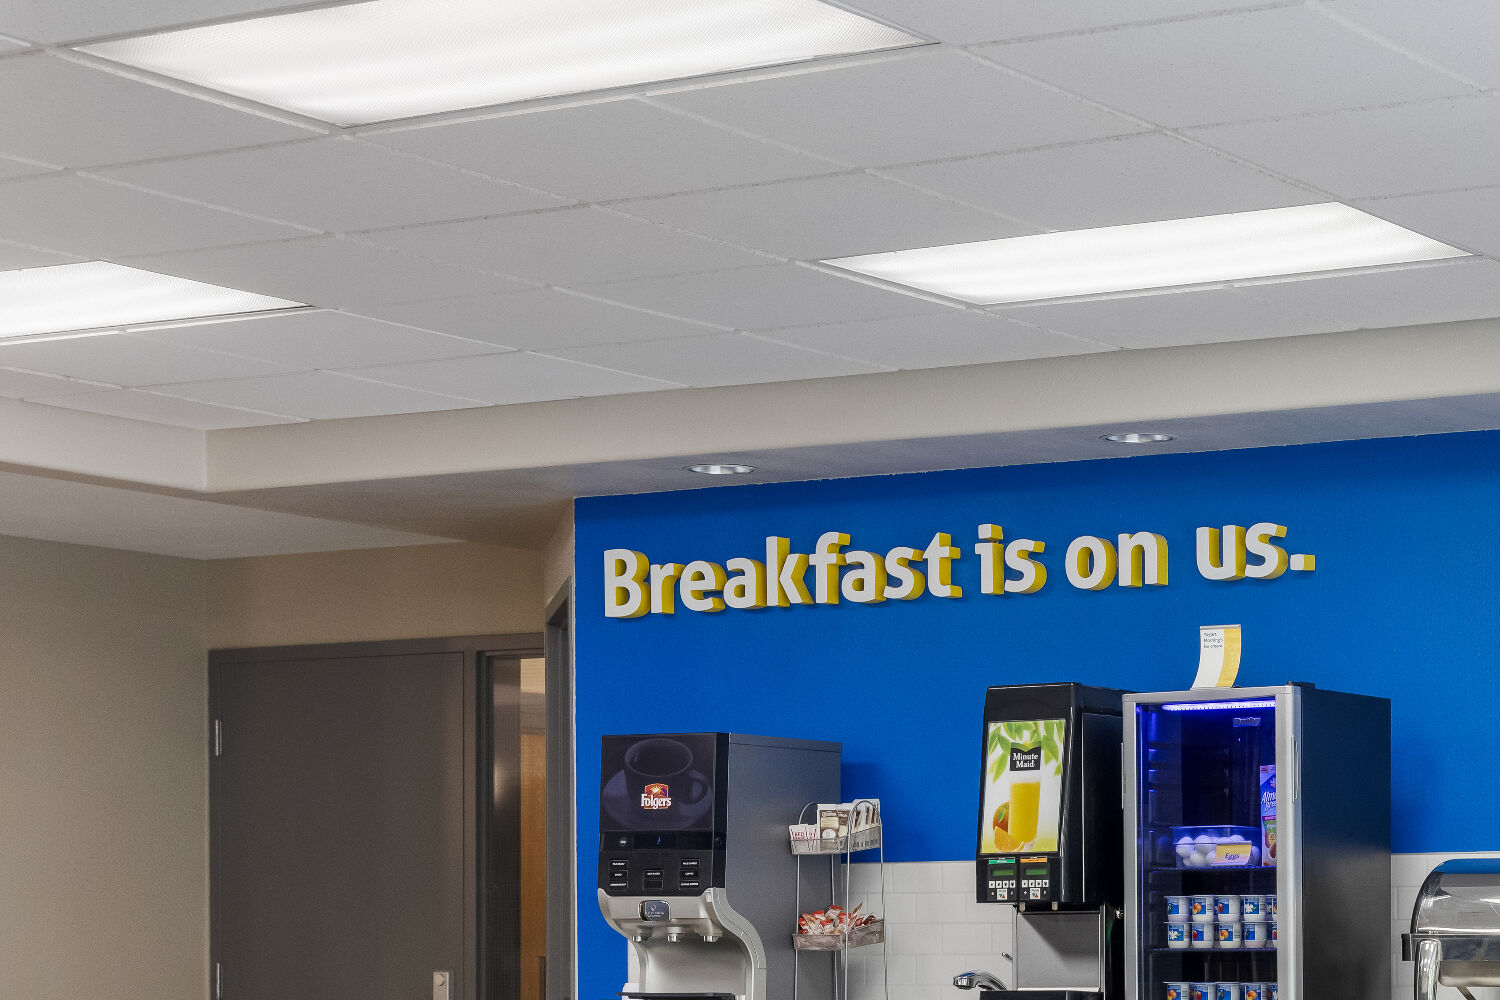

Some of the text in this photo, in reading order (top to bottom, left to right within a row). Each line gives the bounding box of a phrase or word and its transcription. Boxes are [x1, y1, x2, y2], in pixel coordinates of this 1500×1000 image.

[603, 522, 1316, 618] Breakfast is on us.
[1012, 752, 1039, 761] Minute
[1015, 760, 1035, 769] Maid
[640, 793, 672, 810] Folgers
[1224, 852, 1240, 861] Eggs
